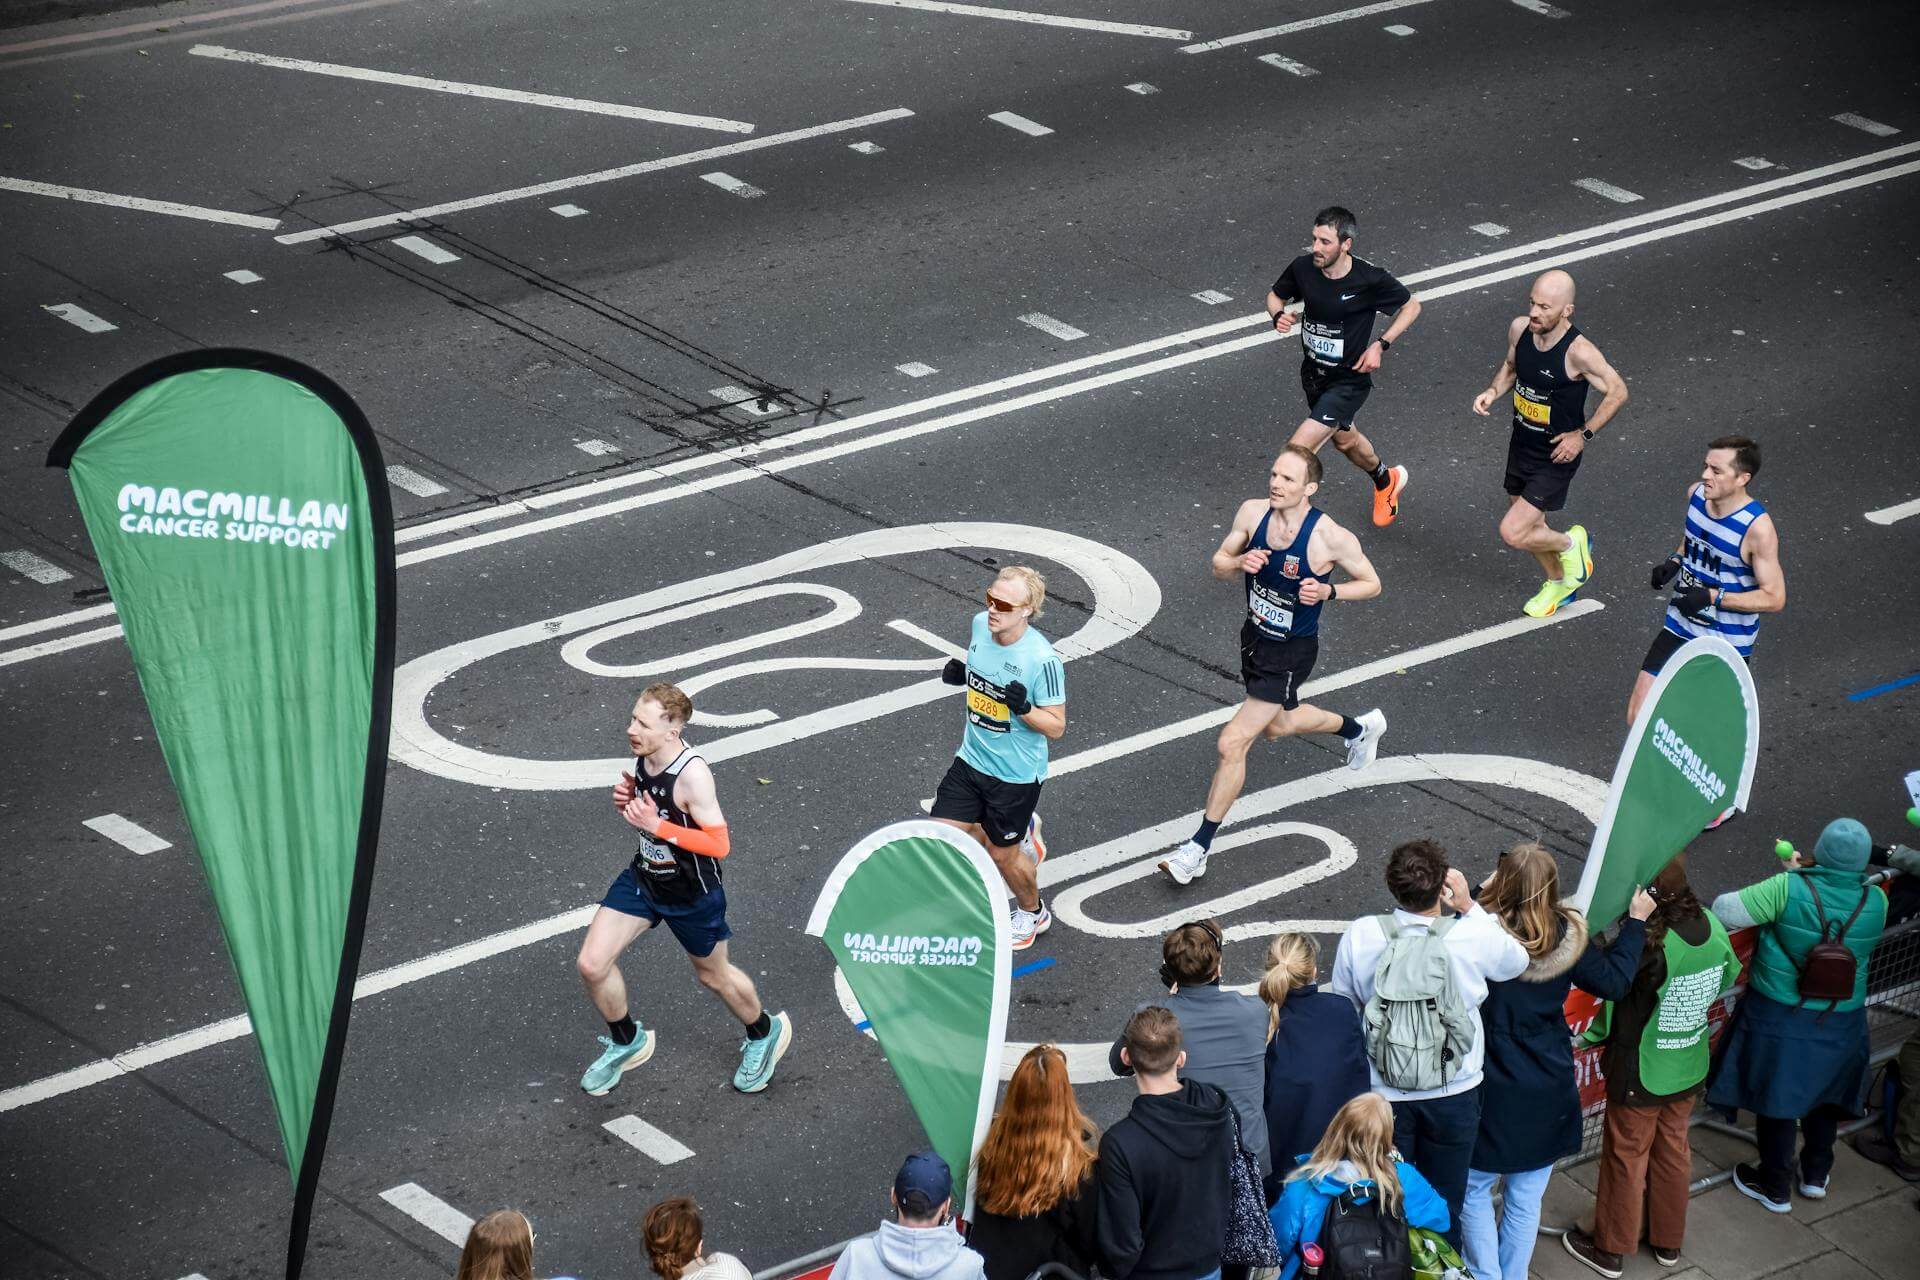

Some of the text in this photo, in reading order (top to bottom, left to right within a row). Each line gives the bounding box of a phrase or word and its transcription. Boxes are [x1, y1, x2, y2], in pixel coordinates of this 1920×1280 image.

[117, 483, 348, 531] MACMILLAN
[119, 513, 336, 550] CANCER SUPPORT
[1253, 600, 1284, 623] 51205
[974, 697, 998, 717] 5289
[1652, 734, 1717, 804] CANCER SUPPORT
[1654, 717, 1726, 797] MACMILLAN
